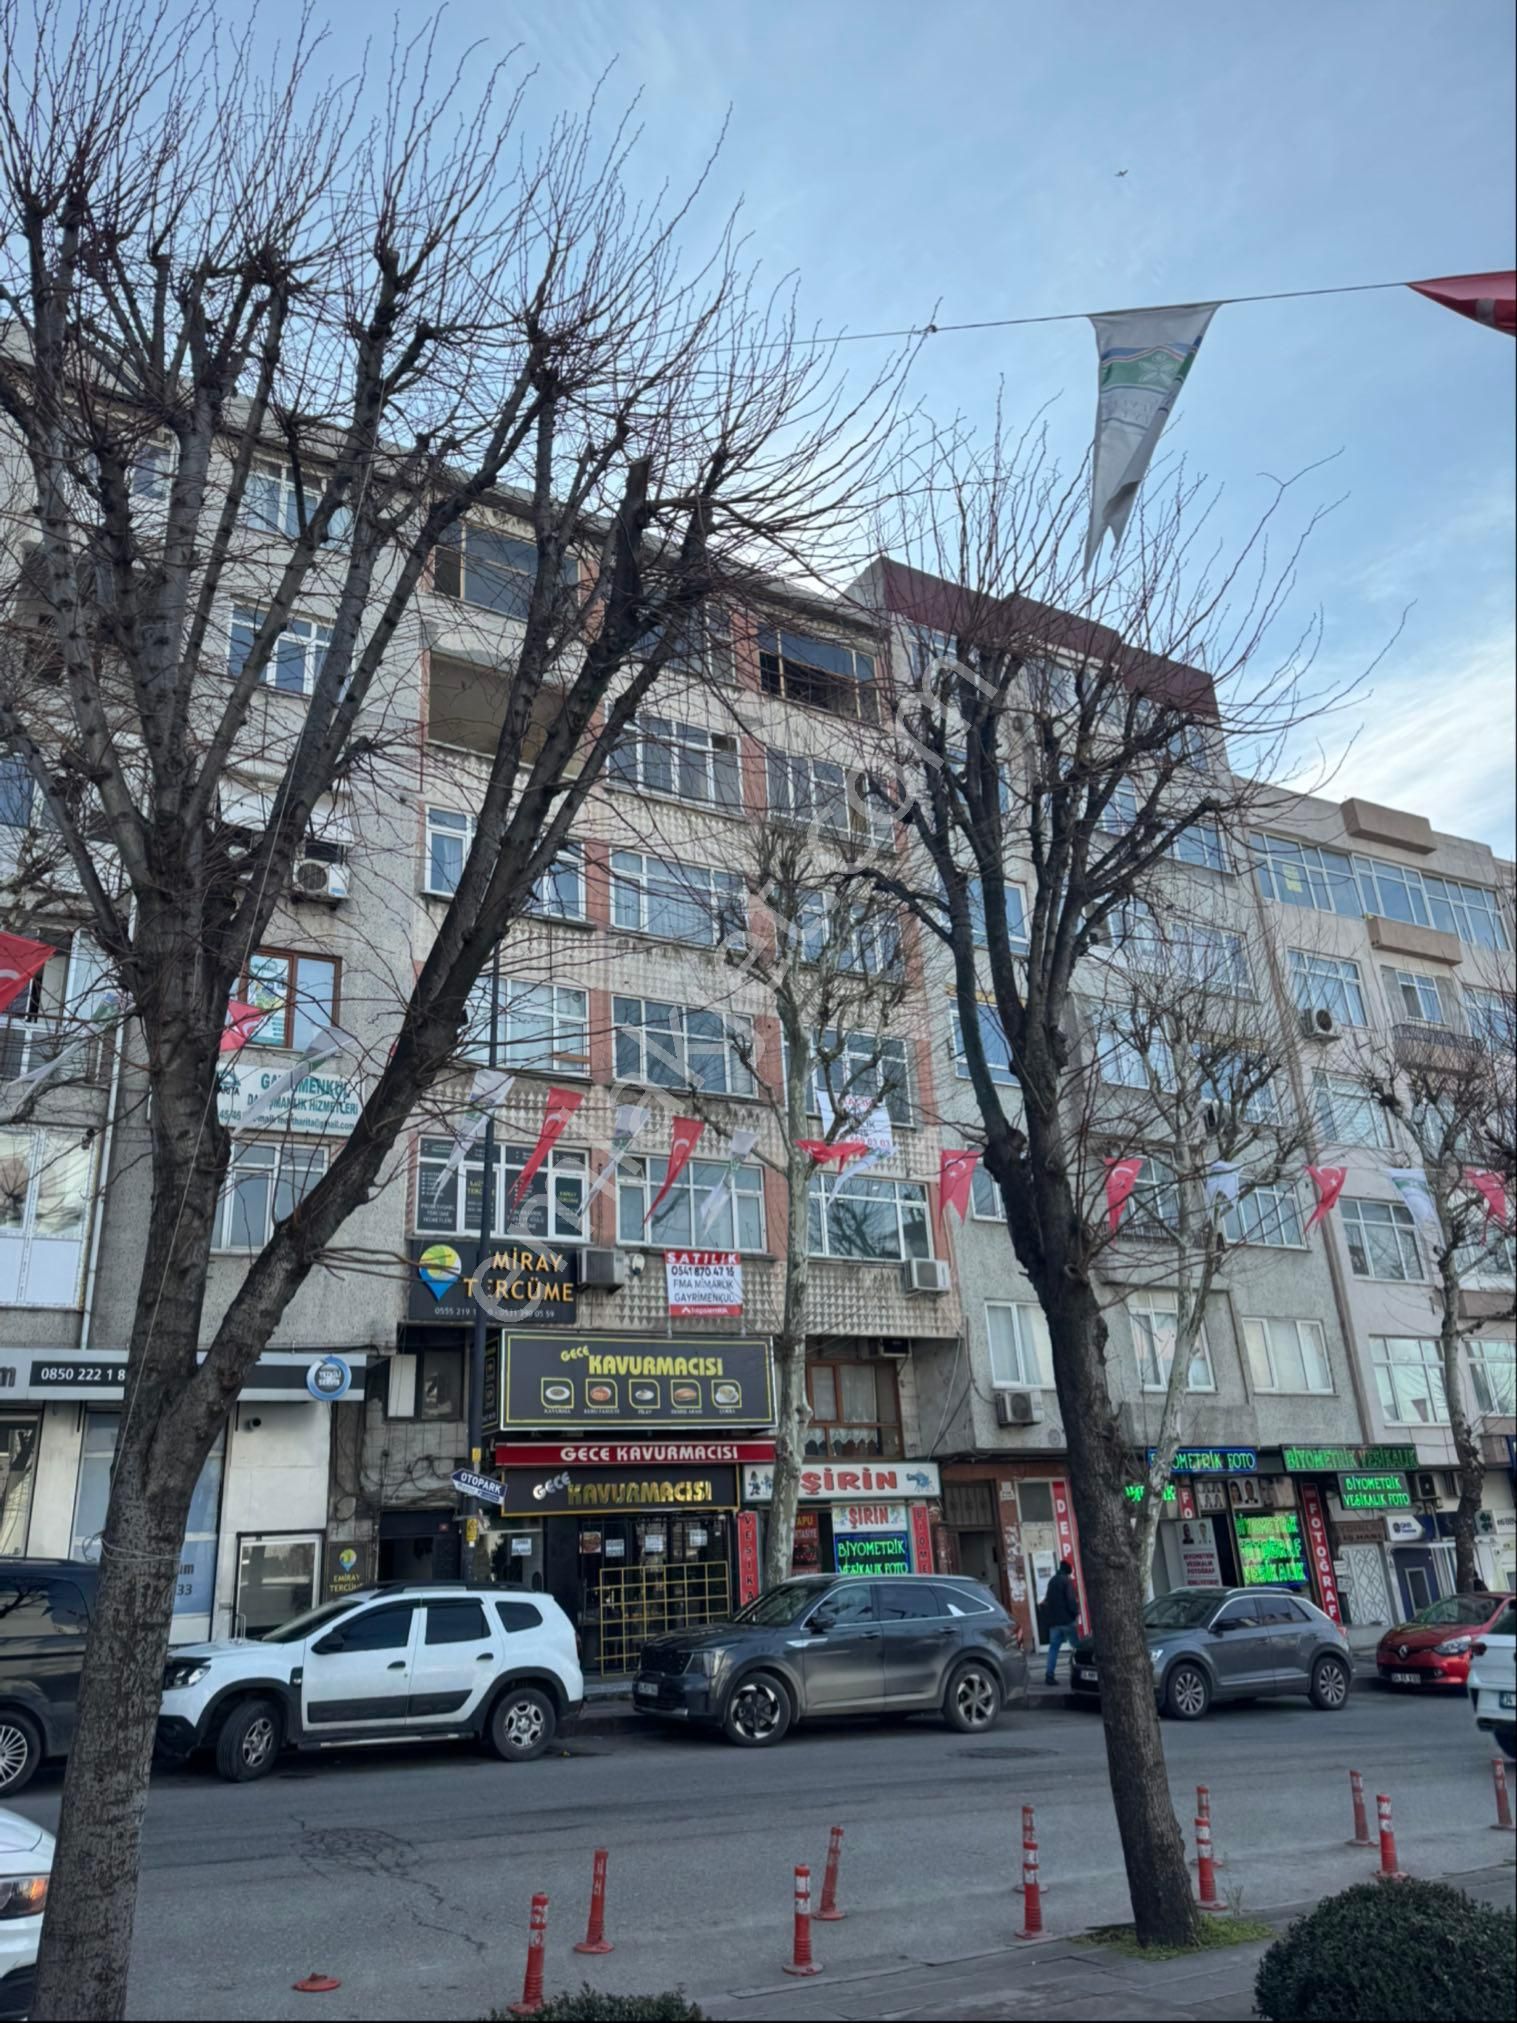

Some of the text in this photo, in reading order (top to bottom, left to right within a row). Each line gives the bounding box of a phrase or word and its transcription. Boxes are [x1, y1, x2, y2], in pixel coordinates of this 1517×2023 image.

[261, 1072, 350, 1100] GAMENKUL
[490, 1247, 563, 1272] MİRAY
[667, 1252, 737, 1265] SATILIK
[464, 1277, 574, 1302] TRCÜME
[560, 1345, 723, 1376] GECE KAVURMACISI
[41, 1367, 74, 1380] 0850
[77, 1368, 101, 1381] 222
[560, 1446, 738, 1462] GECE KAVURMACISI
[1150, 1451, 1223, 1470] BOMETRİK
[460, 1472, 502, 1494] OTOPARK
[533, 1471, 713, 1505] GECE KAVURMACISI
[800, 1467, 898, 1495] ŞİRİN
[848, 1504, 889, 1529] ŞİRİN
[837, 1539, 906, 1558] BİYOMETRİK
[1308, 1503, 1337, 1618] FOTOĞRAF
[329, 1582, 364, 1592] TERCÜM
